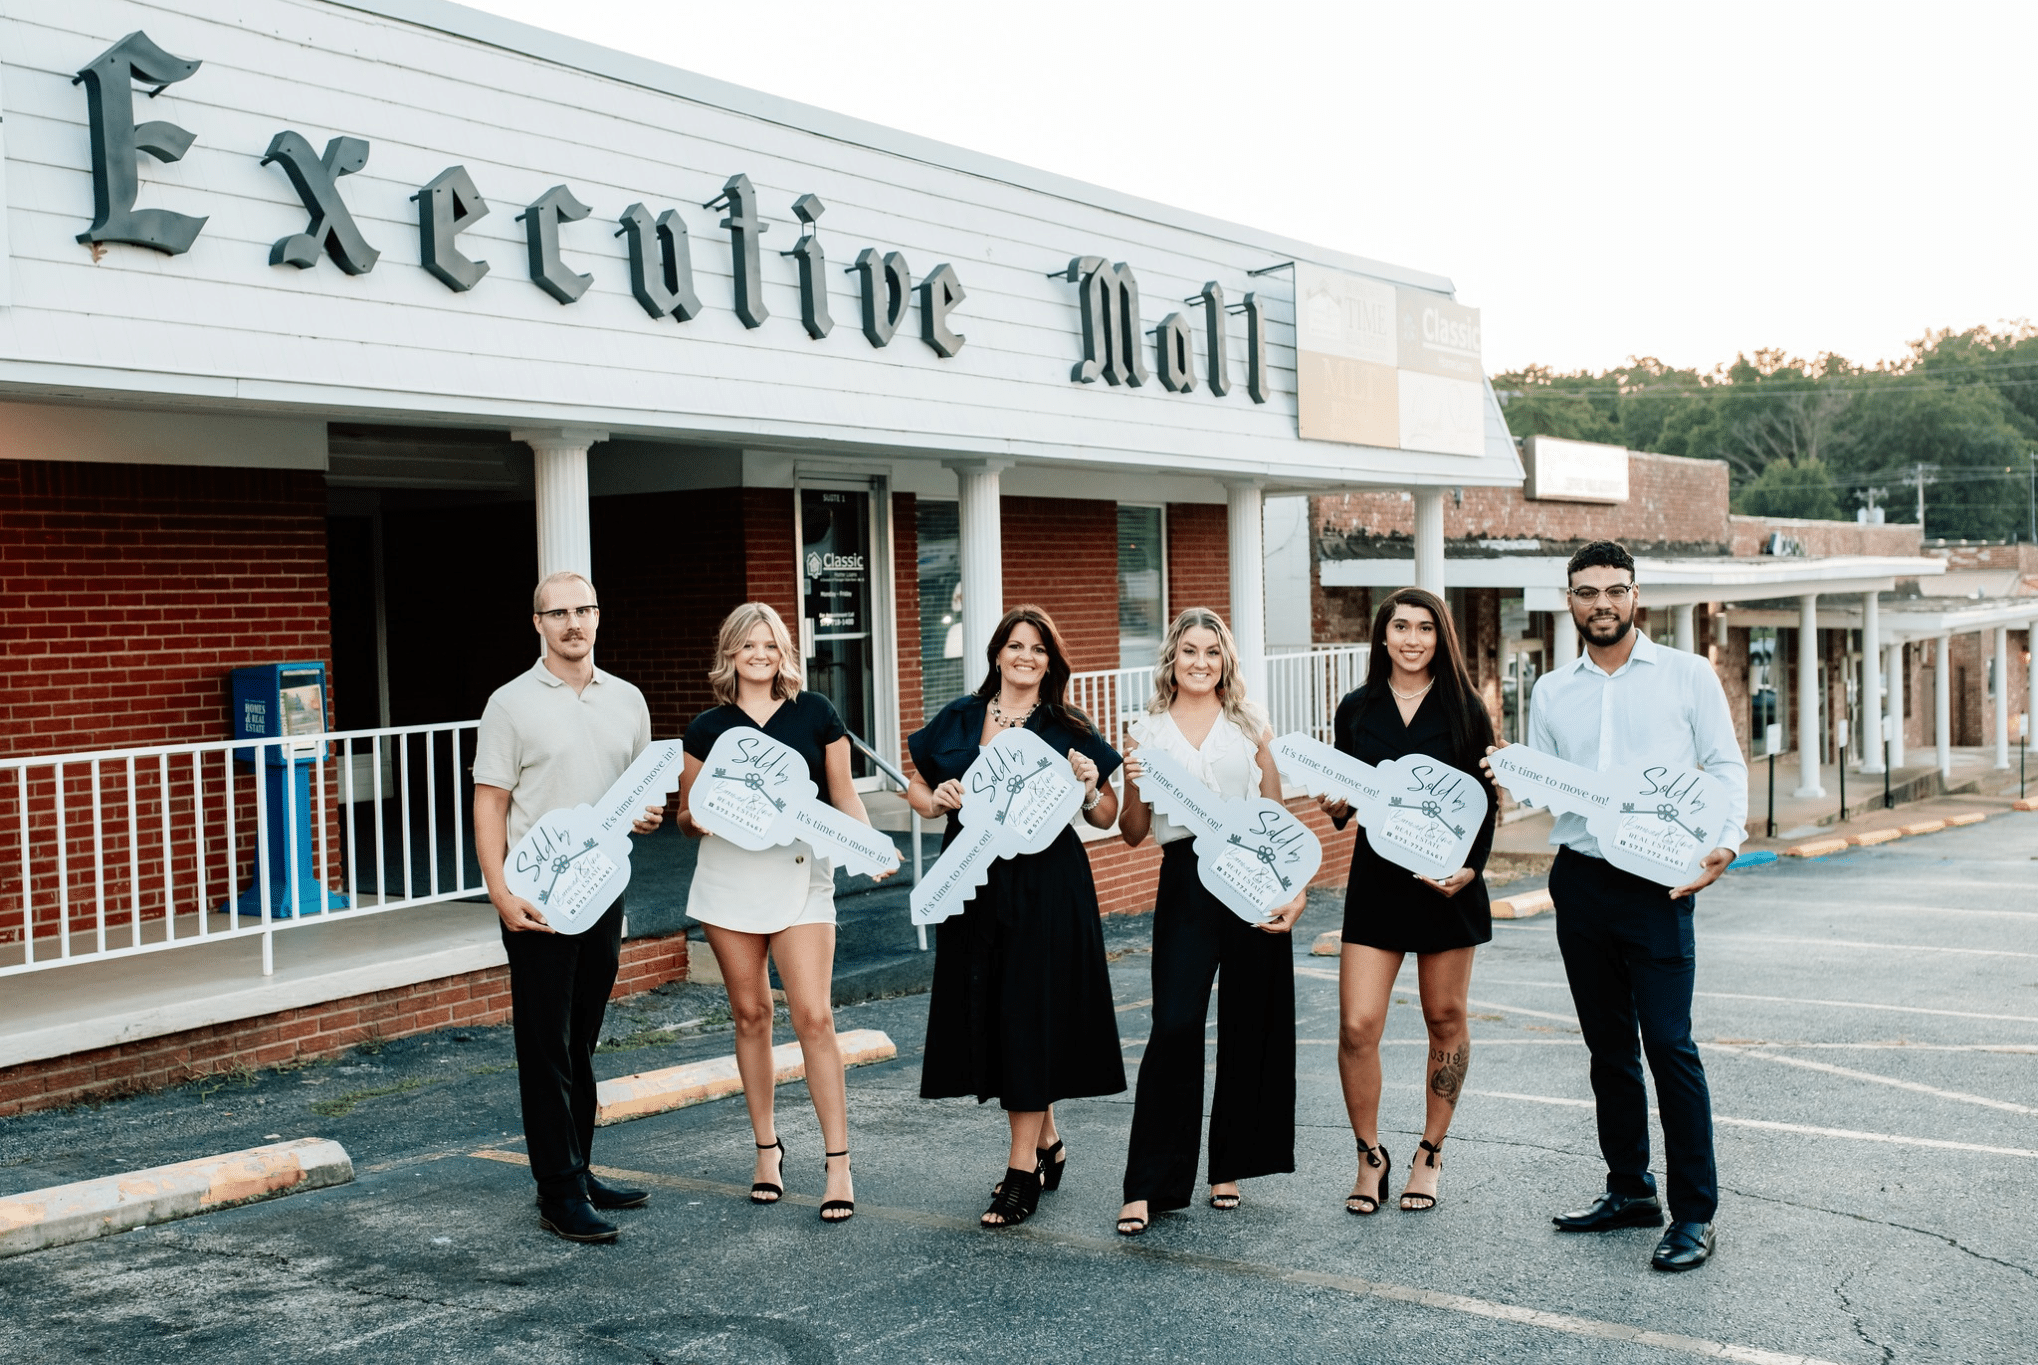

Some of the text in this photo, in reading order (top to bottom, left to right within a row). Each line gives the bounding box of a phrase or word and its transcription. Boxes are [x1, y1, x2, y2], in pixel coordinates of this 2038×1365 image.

[76, 30, 1270, 405] Executive Mall
[1344, 296, 1387, 336] TIME
[1422, 307, 1480, 351] Classic
[823, 552, 864, 568] Classic
[244, 703, 266, 714] HOMES
[245, 712, 265, 724] & REAL
[245, 724, 266, 734] ESTATE
[732, 738, 790, 786] Sold by
[972, 746, 1024, 802] Sold by
[1281, 744, 1380, 798] It's time to move on!
[1499, 758, 1610, 806] It's time to move on!
[602, 747, 676, 831] It's time to move in!
[717, 796, 761, 822] REAL ESTATE
[1023, 786, 1056, 825] REAL ESTATE
[1152, 771, 1173, 790] time
[1173, 788, 1184, 800] to
[1184, 797, 1208, 818] move
[1207, 818, 1224, 832] on!
[1407, 765, 1468, 813] Sold by
[1639, 766, 1708, 815] Sold by
[517, 826, 571, 882] Sold by
[796, 810, 891, 866] It's time to move in!
[1249, 810, 1304, 864] Sold by
[1394, 826, 1440, 850] REAL ESTATE
[1628, 832, 1680, 855] REAL ESTATE
[566, 866, 601, 905] REAL ESTATE
[920, 830, 992, 916] It's time to move on!
[1226, 862, 1264, 894] REAL ESTATE
[1430, 1048, 1461, 1065] 0319
